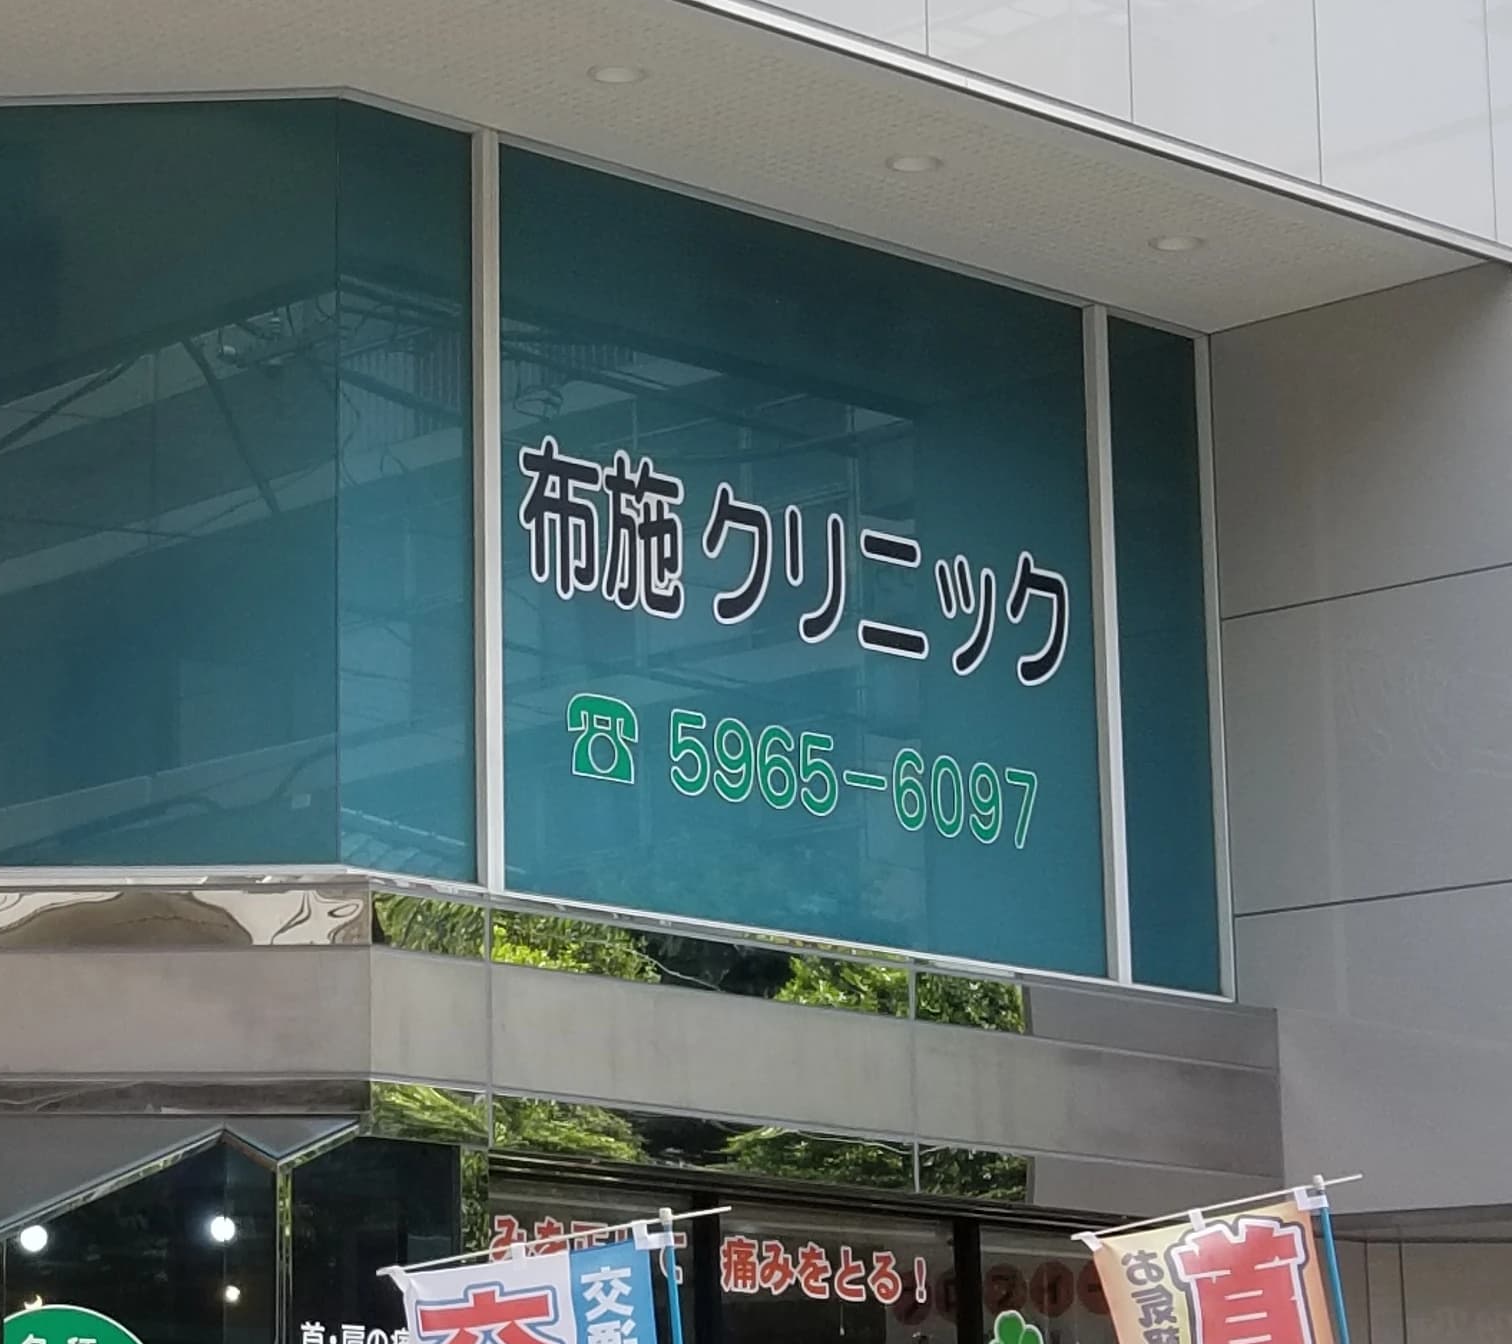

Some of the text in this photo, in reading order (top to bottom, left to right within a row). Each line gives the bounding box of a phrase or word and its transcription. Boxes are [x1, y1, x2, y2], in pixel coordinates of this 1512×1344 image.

[519, 436, 1069, 686] 布施クリニック
[669, 708, 1038, 849] 5965-6097
[721, 1236, 927, 1305] 痛みをとる!
